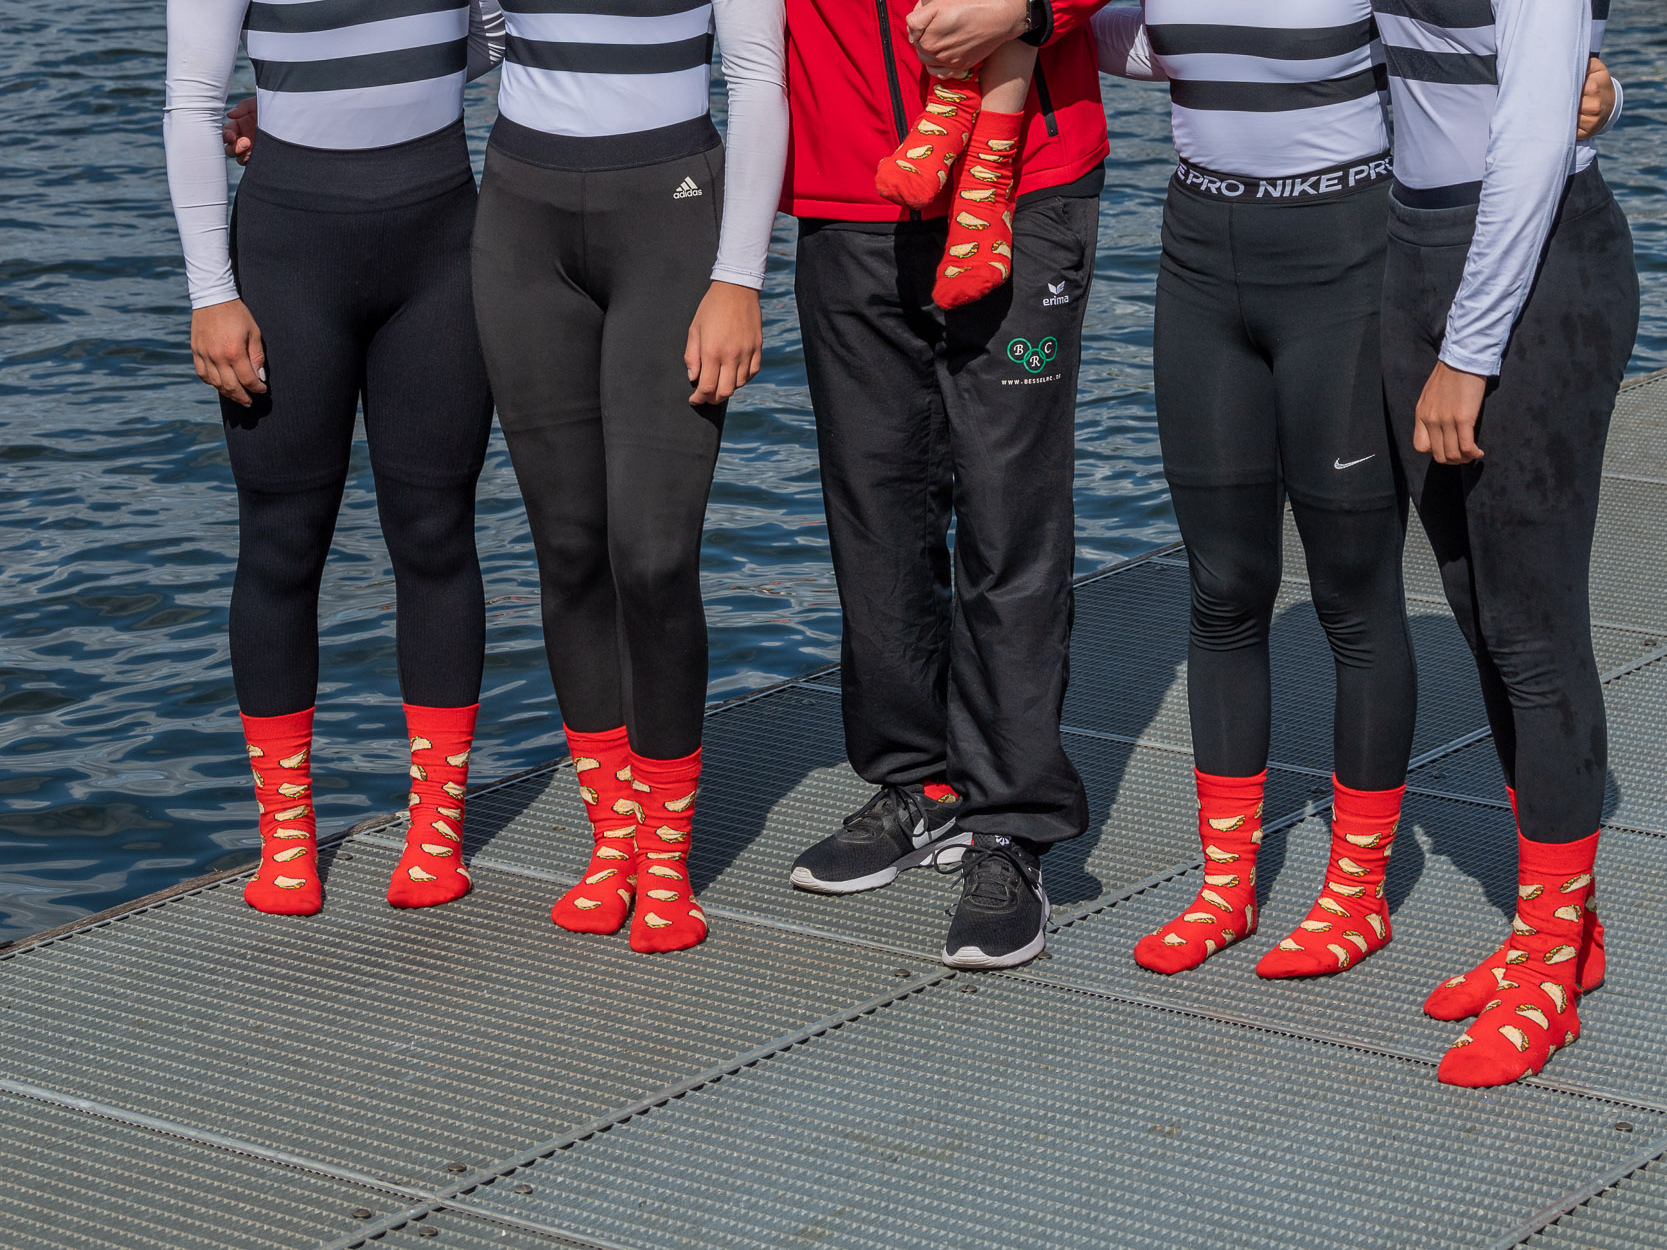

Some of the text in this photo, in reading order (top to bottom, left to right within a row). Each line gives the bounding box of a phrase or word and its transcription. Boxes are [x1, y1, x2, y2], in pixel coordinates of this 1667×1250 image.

[1186, 169, 1245, 197] PRO
[1256, 171, 1343, 198] NIKE
[673, 188, 703, 200] adidas
[1042, 295, 1069, 307] erima
